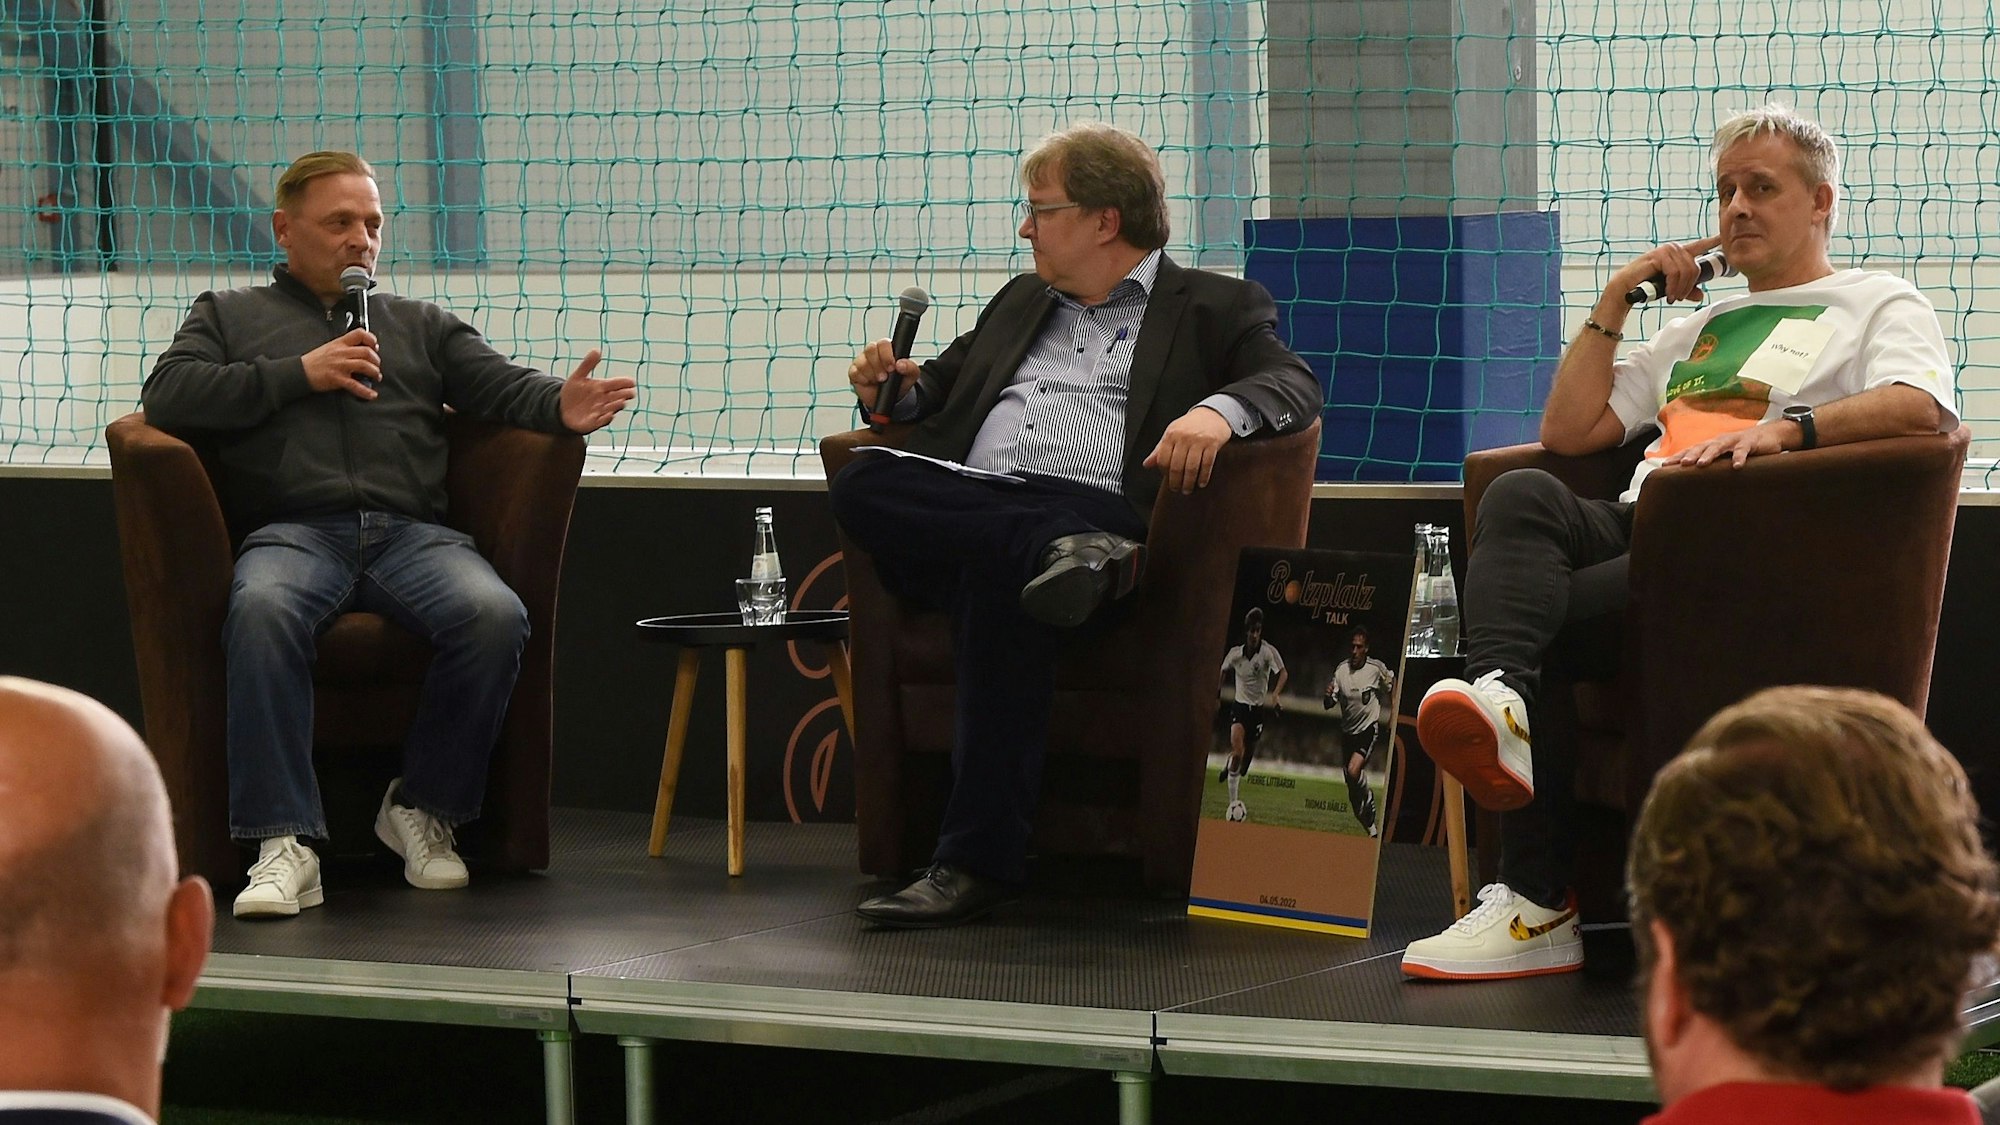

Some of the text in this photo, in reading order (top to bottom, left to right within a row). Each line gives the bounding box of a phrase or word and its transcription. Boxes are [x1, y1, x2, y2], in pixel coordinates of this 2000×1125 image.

[1771, 343, 1809, 359] Why not?
[1326, 611, 1350, 625] TALK
[1248, 775, 1265, 785] PIERRE
[1305, 798, 1326, 810] THOMAS
[1260, 895, 1297, 907] 04.05.2022
